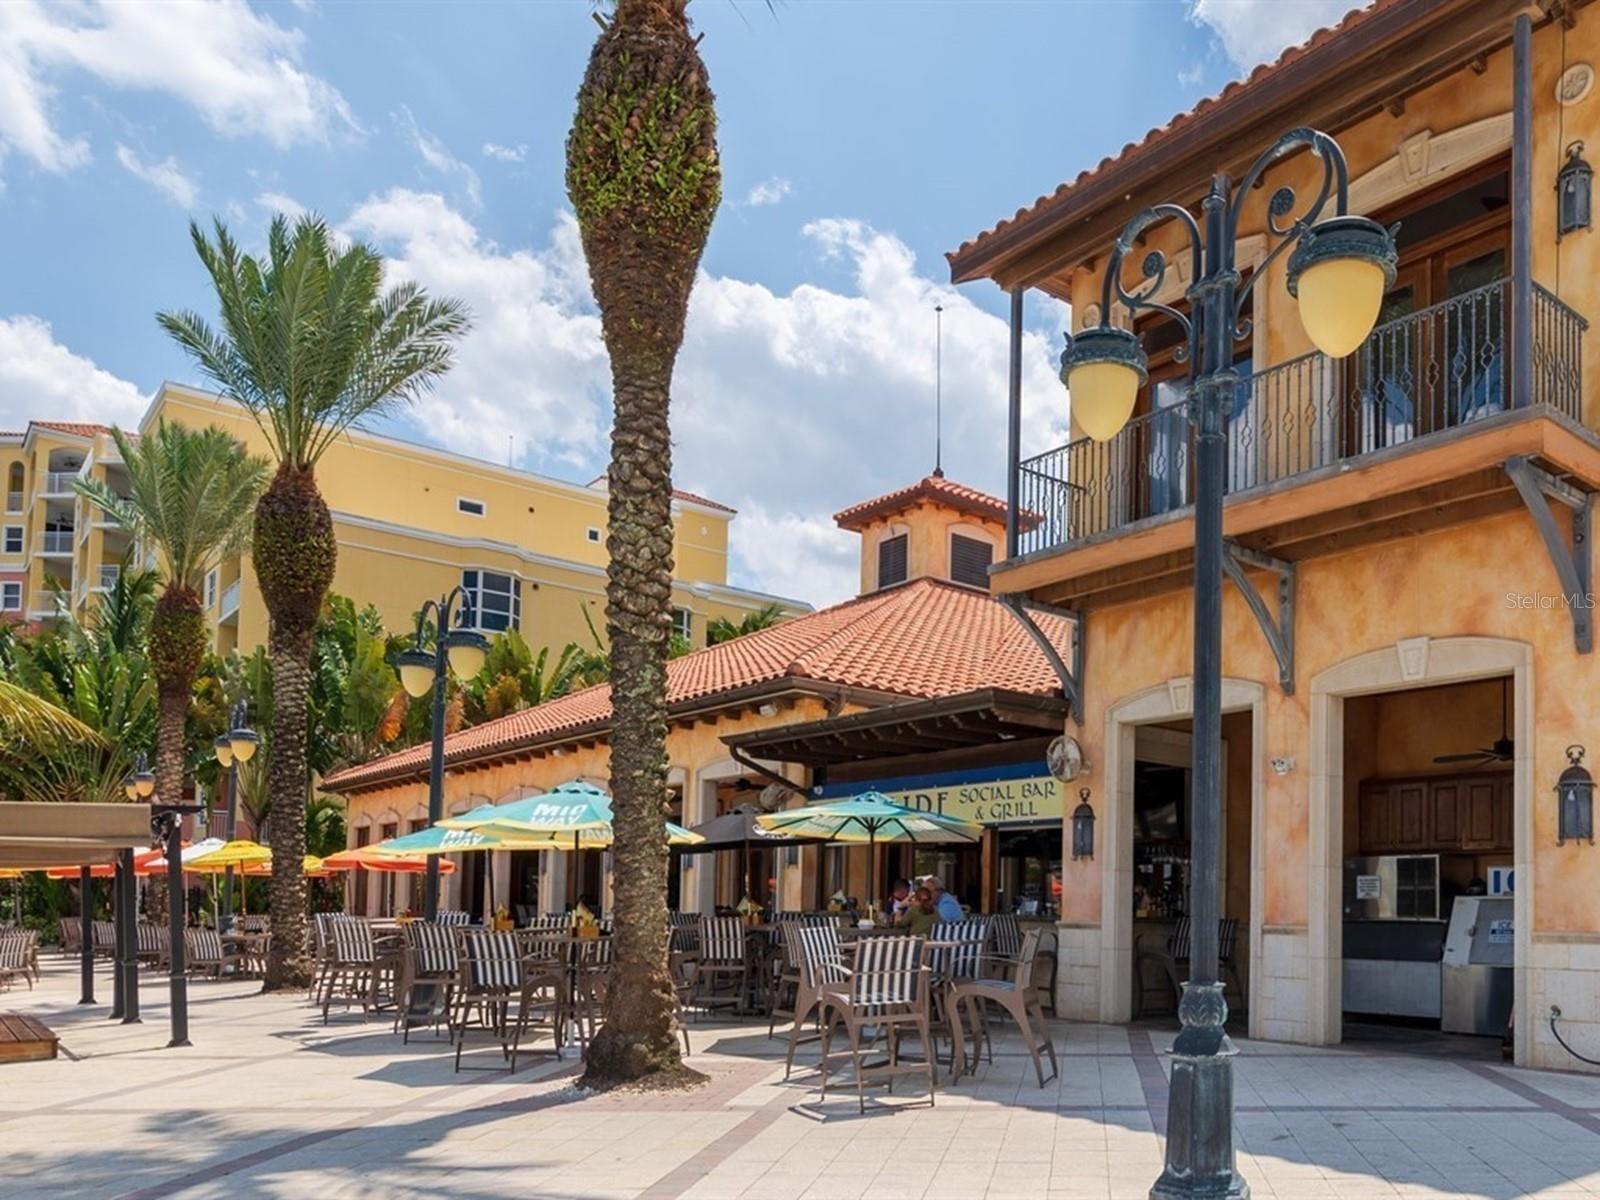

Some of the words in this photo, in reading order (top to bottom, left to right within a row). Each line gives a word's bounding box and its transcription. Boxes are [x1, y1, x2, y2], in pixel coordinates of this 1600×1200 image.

[959, 785, 1015, 804] SOCIAL
[1021, 780, 1056, 799] BAR
[975, 806, 984, 820] &
[990, 801, 1038, 820] GRILL
